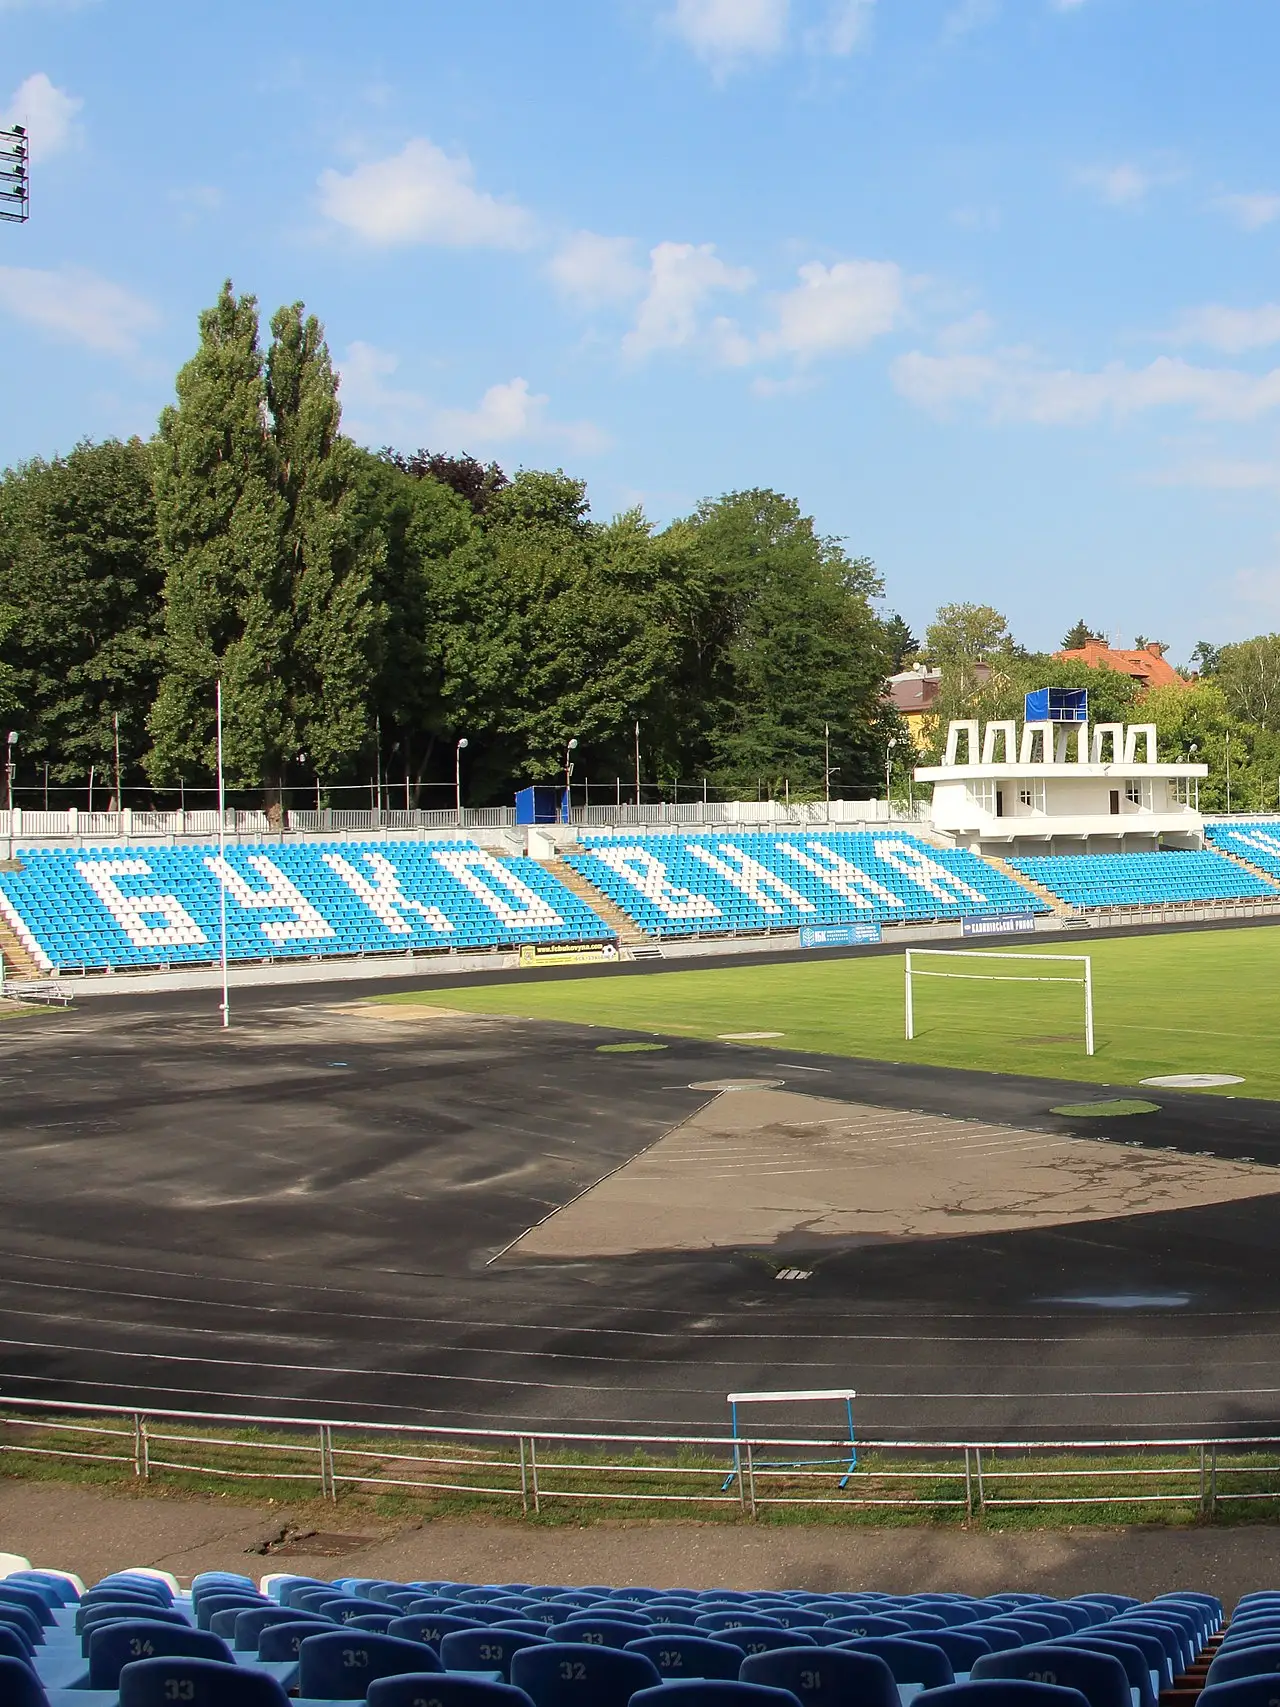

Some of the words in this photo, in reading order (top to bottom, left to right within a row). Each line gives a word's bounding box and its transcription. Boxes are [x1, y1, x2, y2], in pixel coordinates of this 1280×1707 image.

[420, 1628, 441, 1641] 34
[129, 1638, 155, 1656] 34
[479, 1644, 503, 1660] 33
[343, 1649, 369, 1668] 33
[659, 1650, 683, 1667] 32
[560, 1661, 587, 1680] 32
[800, 1670, 821, 1689] 31
[164, 1679, 195, 1700] 33
